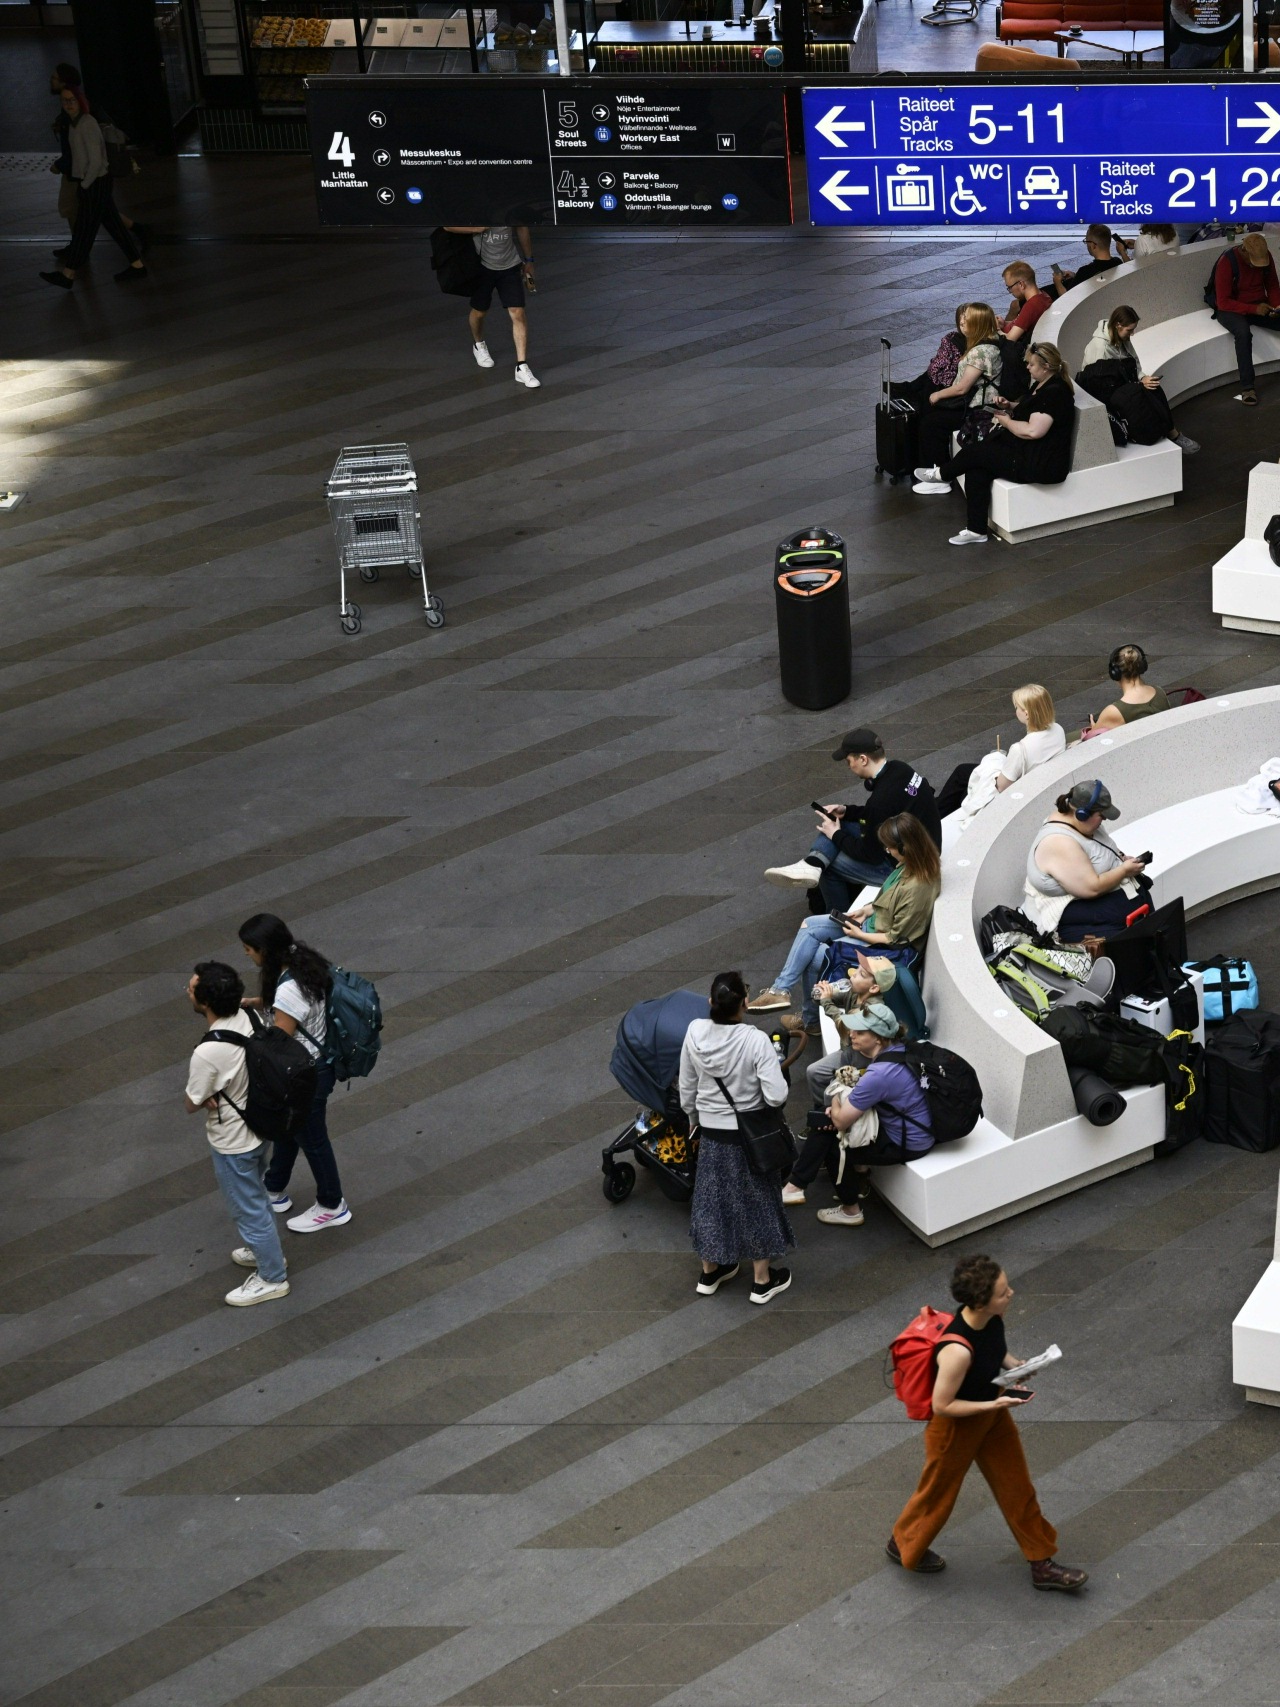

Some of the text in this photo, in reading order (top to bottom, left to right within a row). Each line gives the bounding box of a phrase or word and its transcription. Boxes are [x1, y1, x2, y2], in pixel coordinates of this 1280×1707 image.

[899, 97, 955, 111] Raiteet
[559, 101, 579, 129] 5
[618, 115, 669, 124] Hyvinvointi
[899, 116, 939, 135] Spår
[969, 103, 1064, 145] 5-11
[558, 130, 579, 138] Soul
[620, 134, 657, 143] Workery
[722, 138, 731, 147] W
[900, 137, 953, 152] Tracks
[327, 132, 355, 167] 4
[400, 149, 461, 157] Messukeskus
[969, 164, 1003, 179] WC
[1100, 162, 1155, 176] Raiteet
[332, 171, 355, 179] Little
[623, 172, 660, 180] Parveke
[321, 180, 368, 188] Manhattan
[1101, 180, 1139, 199] Spår
[624, 194, 671, 202] Odotustila
[558, 200, 594, 209] Balcony
[1100, 201, 1153, 215] Tracks
